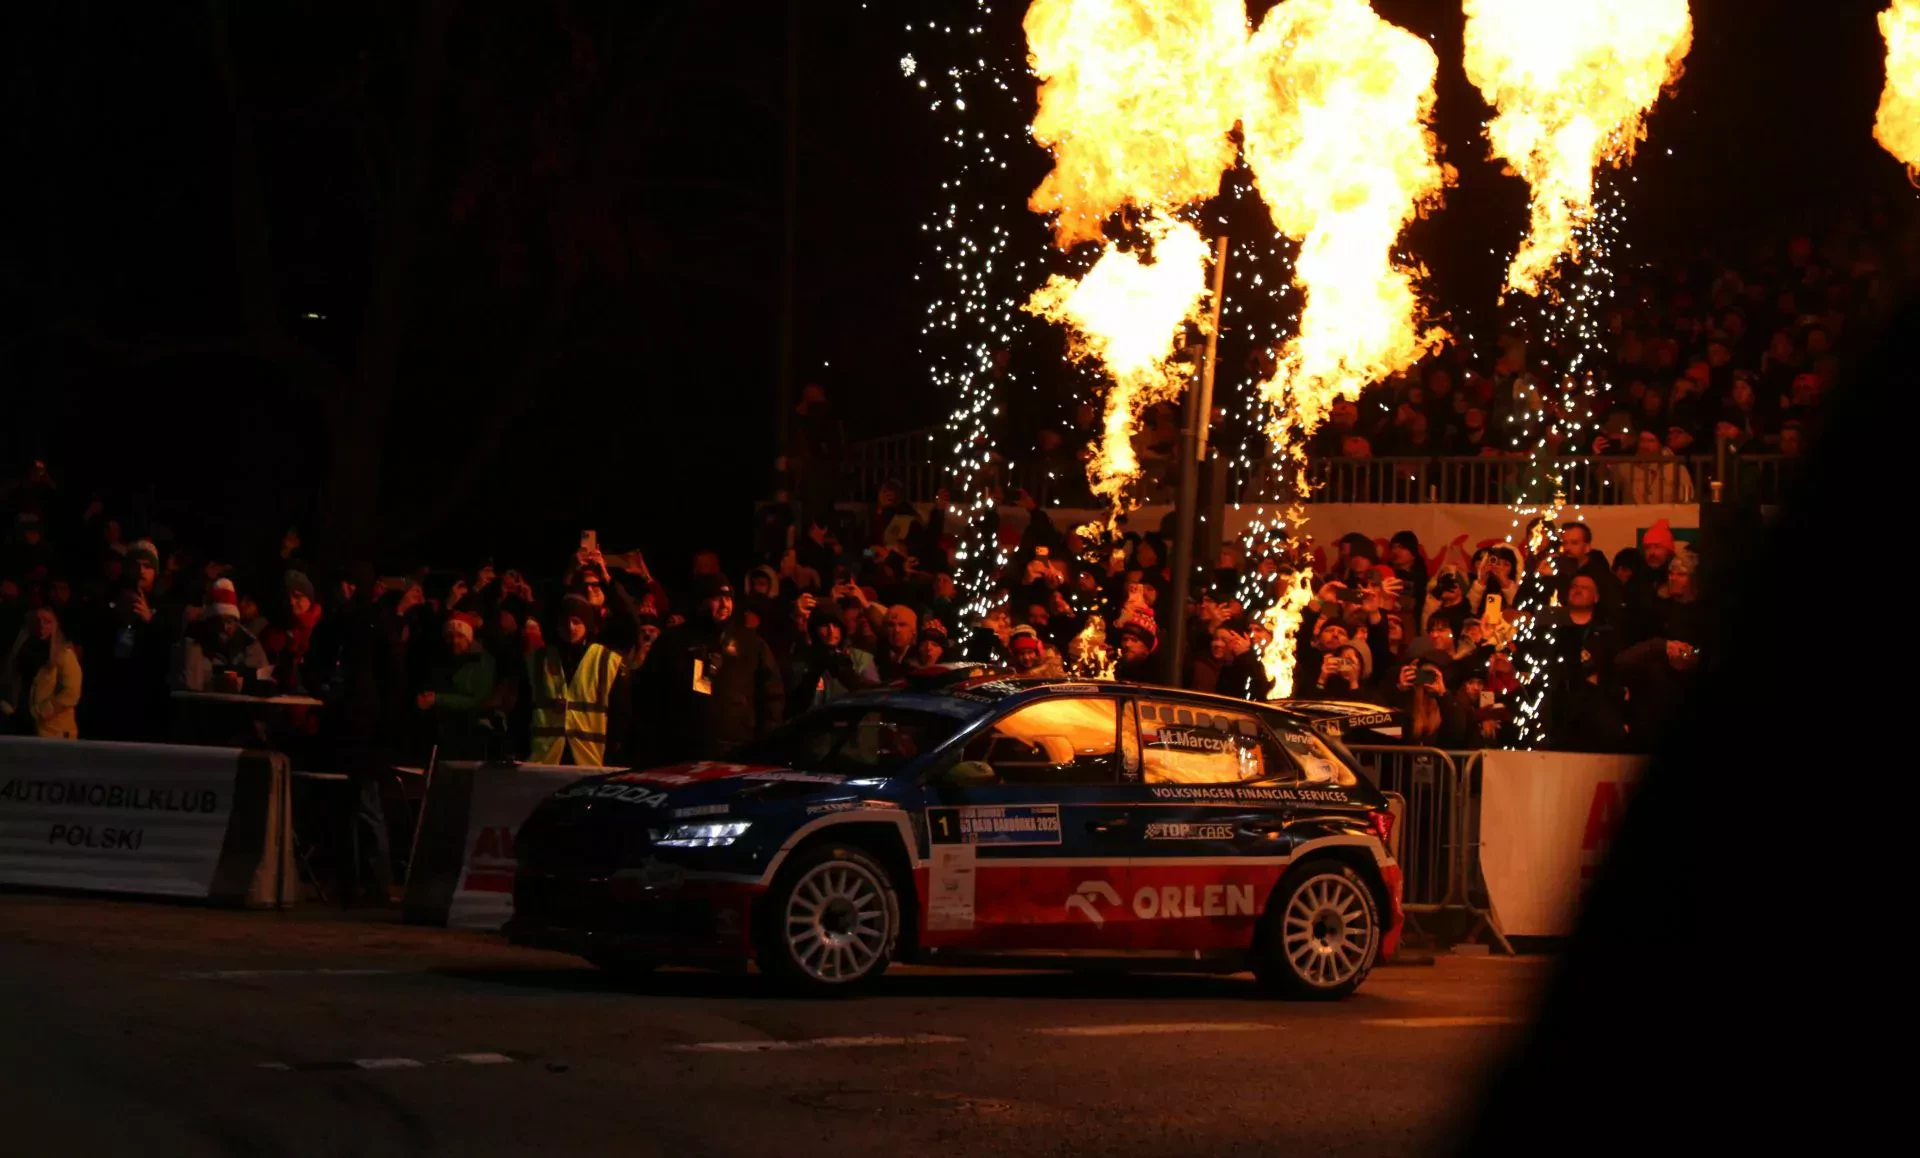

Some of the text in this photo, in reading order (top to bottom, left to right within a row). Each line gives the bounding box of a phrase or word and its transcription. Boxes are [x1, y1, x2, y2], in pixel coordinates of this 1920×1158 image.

[0, 779, 218, 814] AUTOMOBILKLUB
[1152, 787, 1349, 802] VOLKSWAGEN FINANCIAL SERVICES
[50, 824, 144, 850] POLSKI
[938, 815, 949, 837] 1
[1161, 823, 1235, 839] TOP CARS
[1132, 884, 1255, 920] ORLEN
